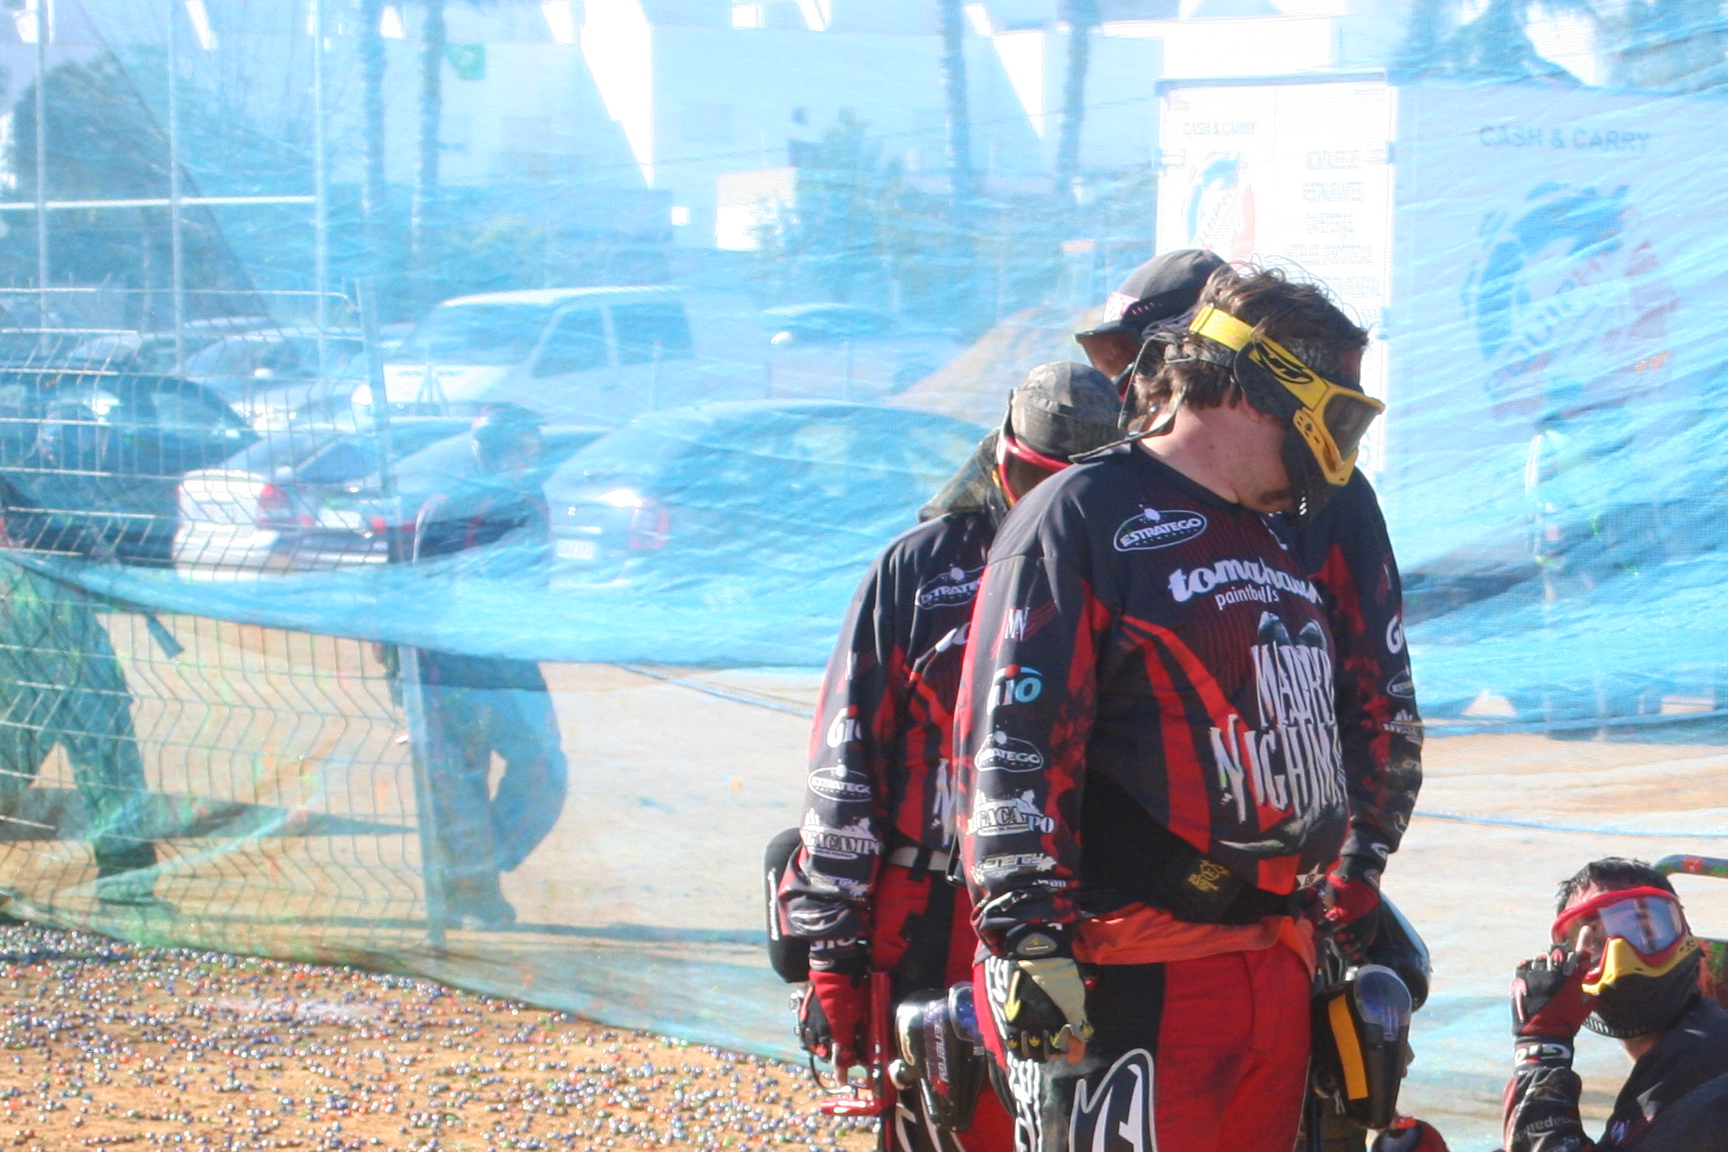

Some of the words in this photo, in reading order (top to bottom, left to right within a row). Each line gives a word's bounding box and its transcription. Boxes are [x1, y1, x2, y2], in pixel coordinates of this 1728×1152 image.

[1479, 125, 1543, 148] CASH
[1550, 129, 1565, 149] &
[1573, 129, 1652, 151] CARRY
[1119, 517, 1203, 548] ESTRATEGO
